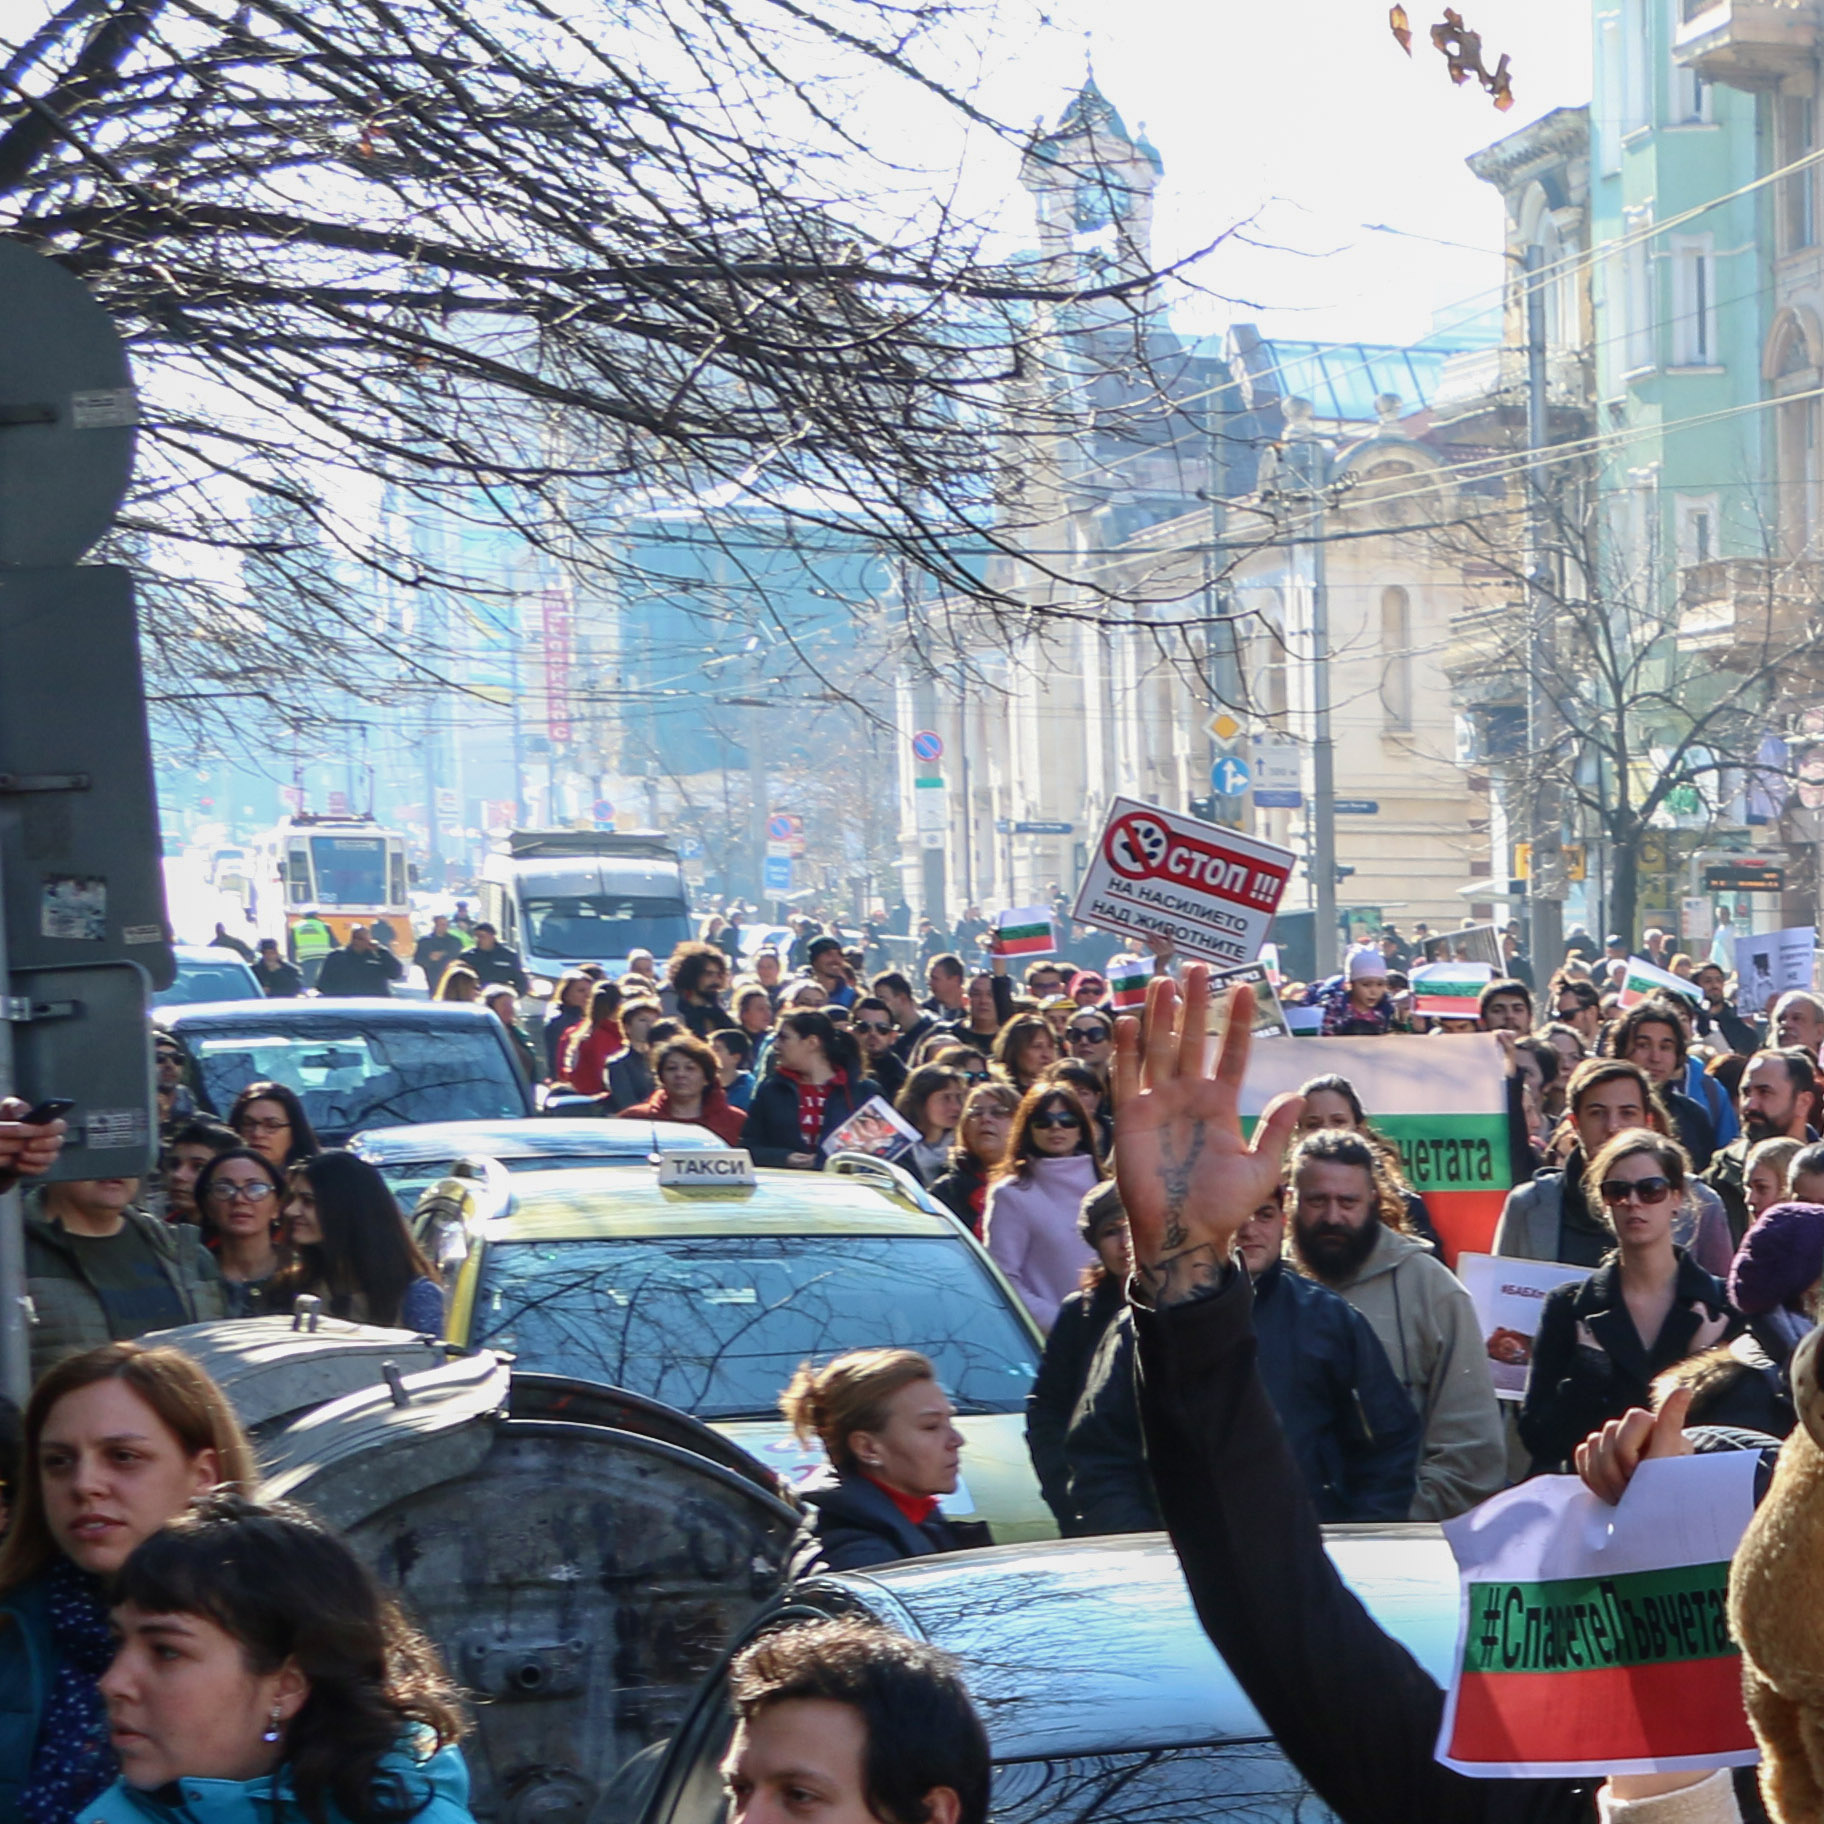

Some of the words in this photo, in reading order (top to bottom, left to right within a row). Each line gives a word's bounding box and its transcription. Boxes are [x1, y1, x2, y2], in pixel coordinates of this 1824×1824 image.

[1167, 845, 1249, 894] СТОП
[1247, 872, 1279, 904] !!!
[1090, 900, 1131, 923] НАД
[1135, 914, 1247, 958] ЖИВОТНИТЕ
[1107, 876, 1133, 895] НА
[1139, 885, 1249, 932] НАСИЛИЕТО
[671, 1159, 746, 1176] ТАКСИ
